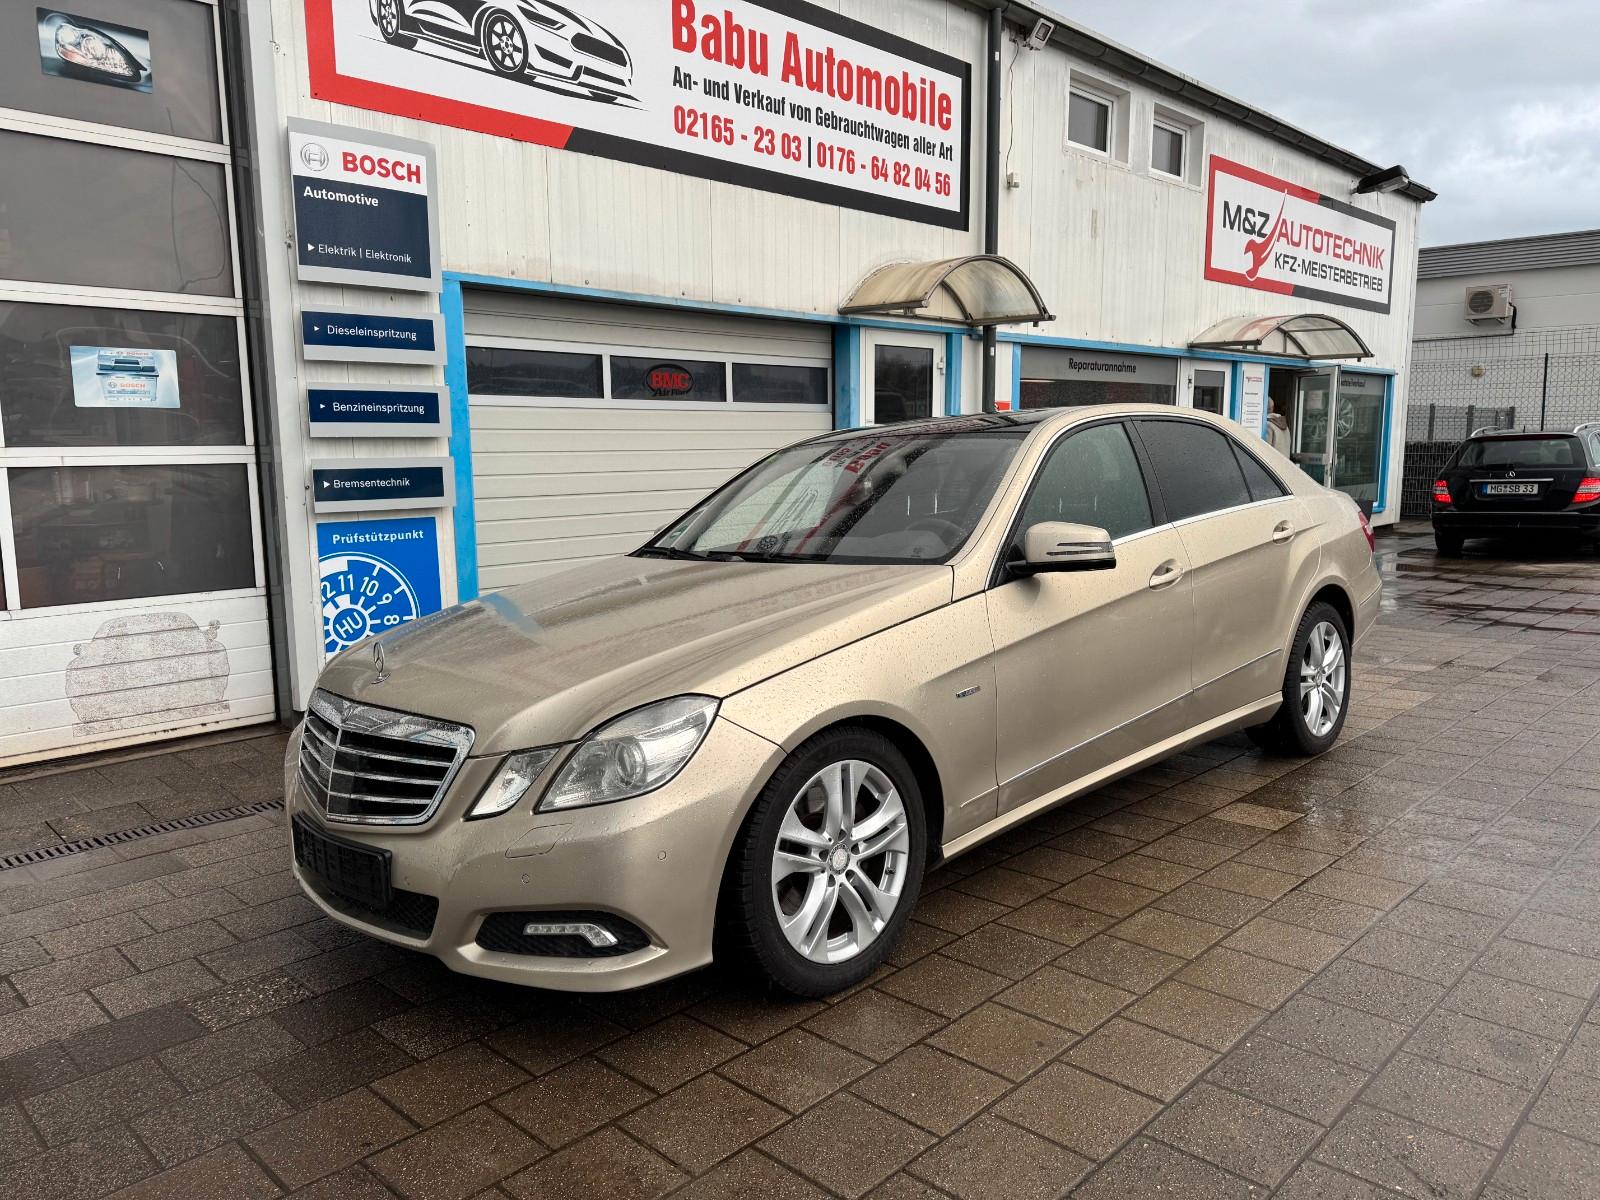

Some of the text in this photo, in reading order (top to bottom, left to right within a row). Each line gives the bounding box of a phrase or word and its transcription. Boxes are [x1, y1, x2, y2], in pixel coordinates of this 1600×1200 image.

[672, 0, 951, 131] Babu Automobile
[673, 65, 952, 162] An- und Verkauf von Gebrauchtwagen aller Art
[673, 105, 734, 146] 02165
[753, 125, 775, 155] 23
[781, 132, 801, 162] 03
[817, 141, 855, 174] 0176
[871, 155, 888, 182] 64
[893, 161, 910, 187] 82
[914, 166, 931, 192] 04
[935, 171, 951, 197] 56
[342, 151, 421, 184] BOSCH
[303, 185, 379, 206] Automotive
[1222, 200, 1386, 271] M&Z AUTOTECHNIK
[318, 244, 357, 257] Elektrik
[365, 249, 412, 263] Elektronik
[327, 325, 417, 341] Dieseleinspritzung
[1068, 357, 1137, 373] Reparaturannahme
[651, 371, 689, 389] BMC
[332, 402, 425, 414] Benzineinspritzung
[333, 477, 411, 489] Bremsentechnik
[1490, 484, 1535, 493] MG SB 33
[332, 529, 424, 545] Prüfstützpunkt
[320, 573, 400, 625] 2 11 10 9 8
[335, 611, 363, 639] HU
